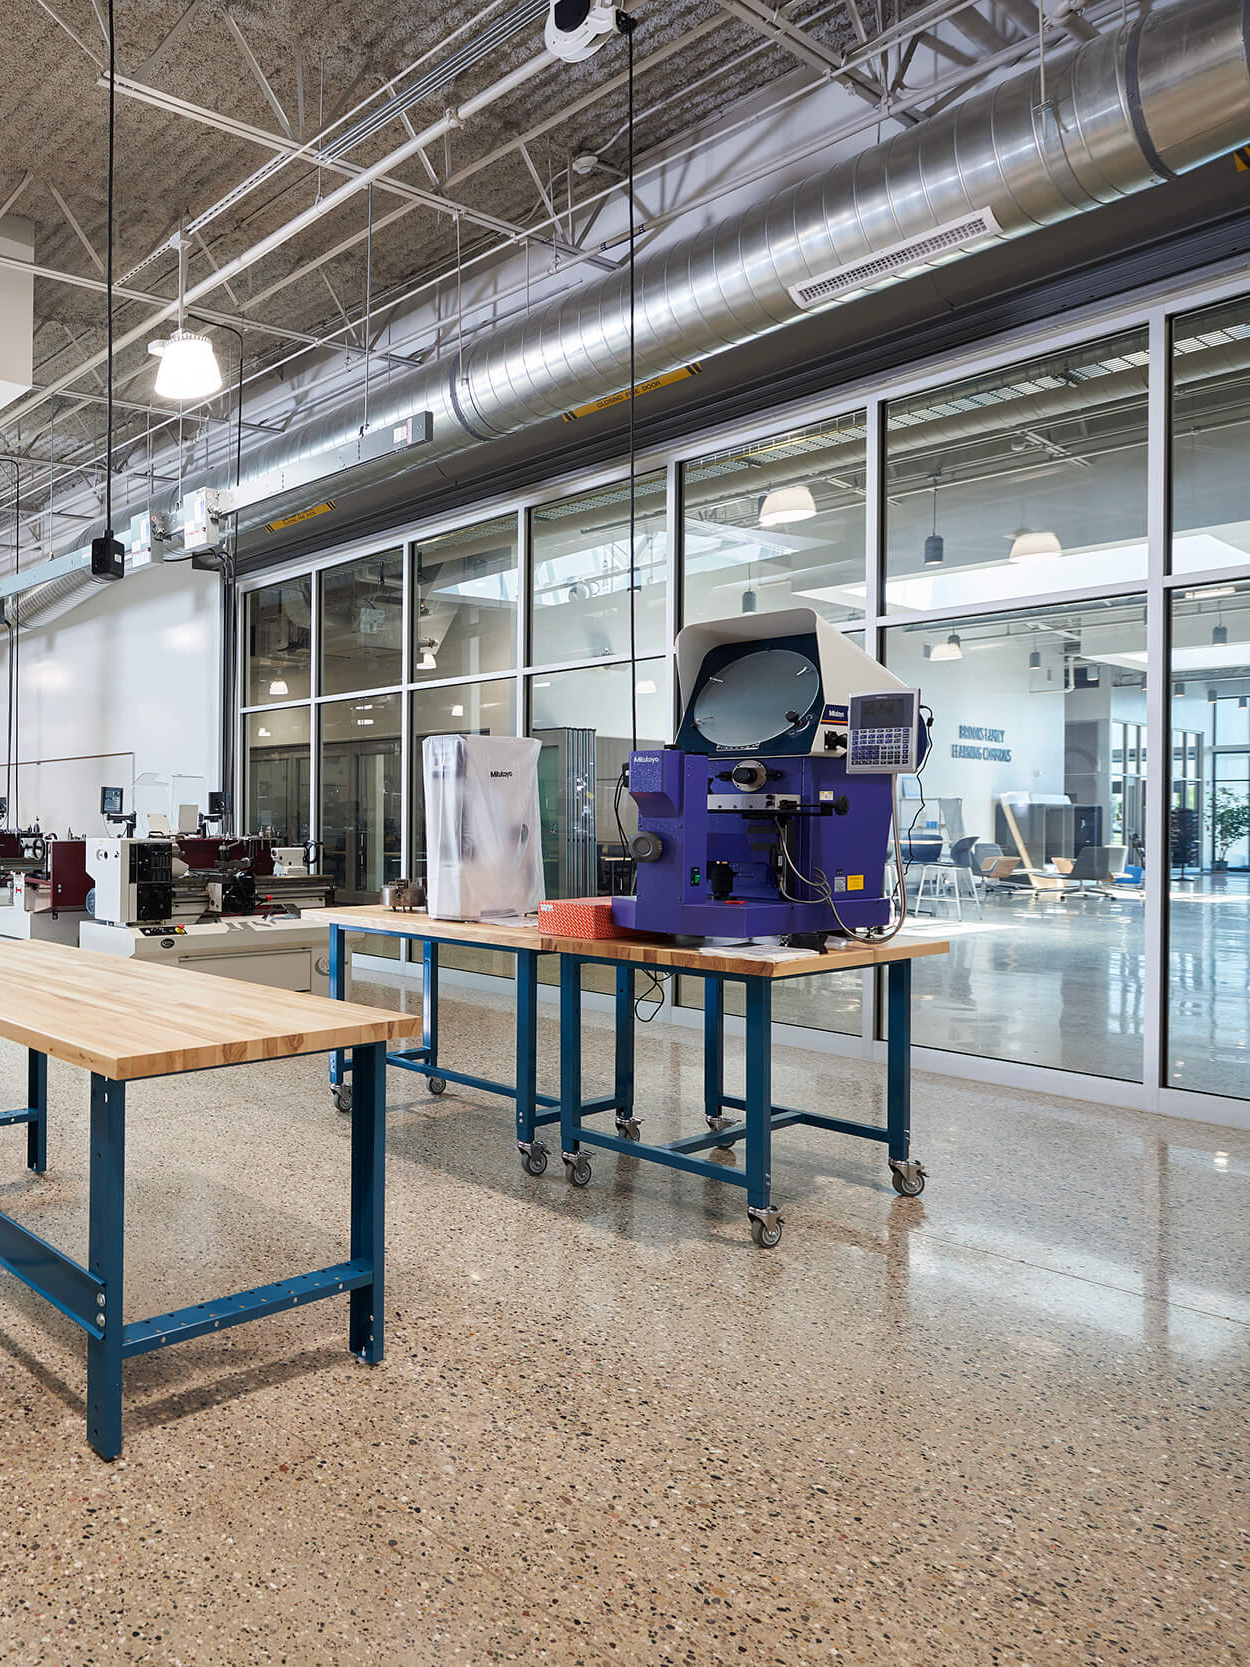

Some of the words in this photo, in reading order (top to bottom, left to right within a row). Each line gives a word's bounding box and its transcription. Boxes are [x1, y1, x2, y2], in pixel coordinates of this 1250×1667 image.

[642, 381, 661, 391] DOOR
[633, 756, 659, 764] Mitutoyo
[490, 770, 513, 778] Mitutoyo
